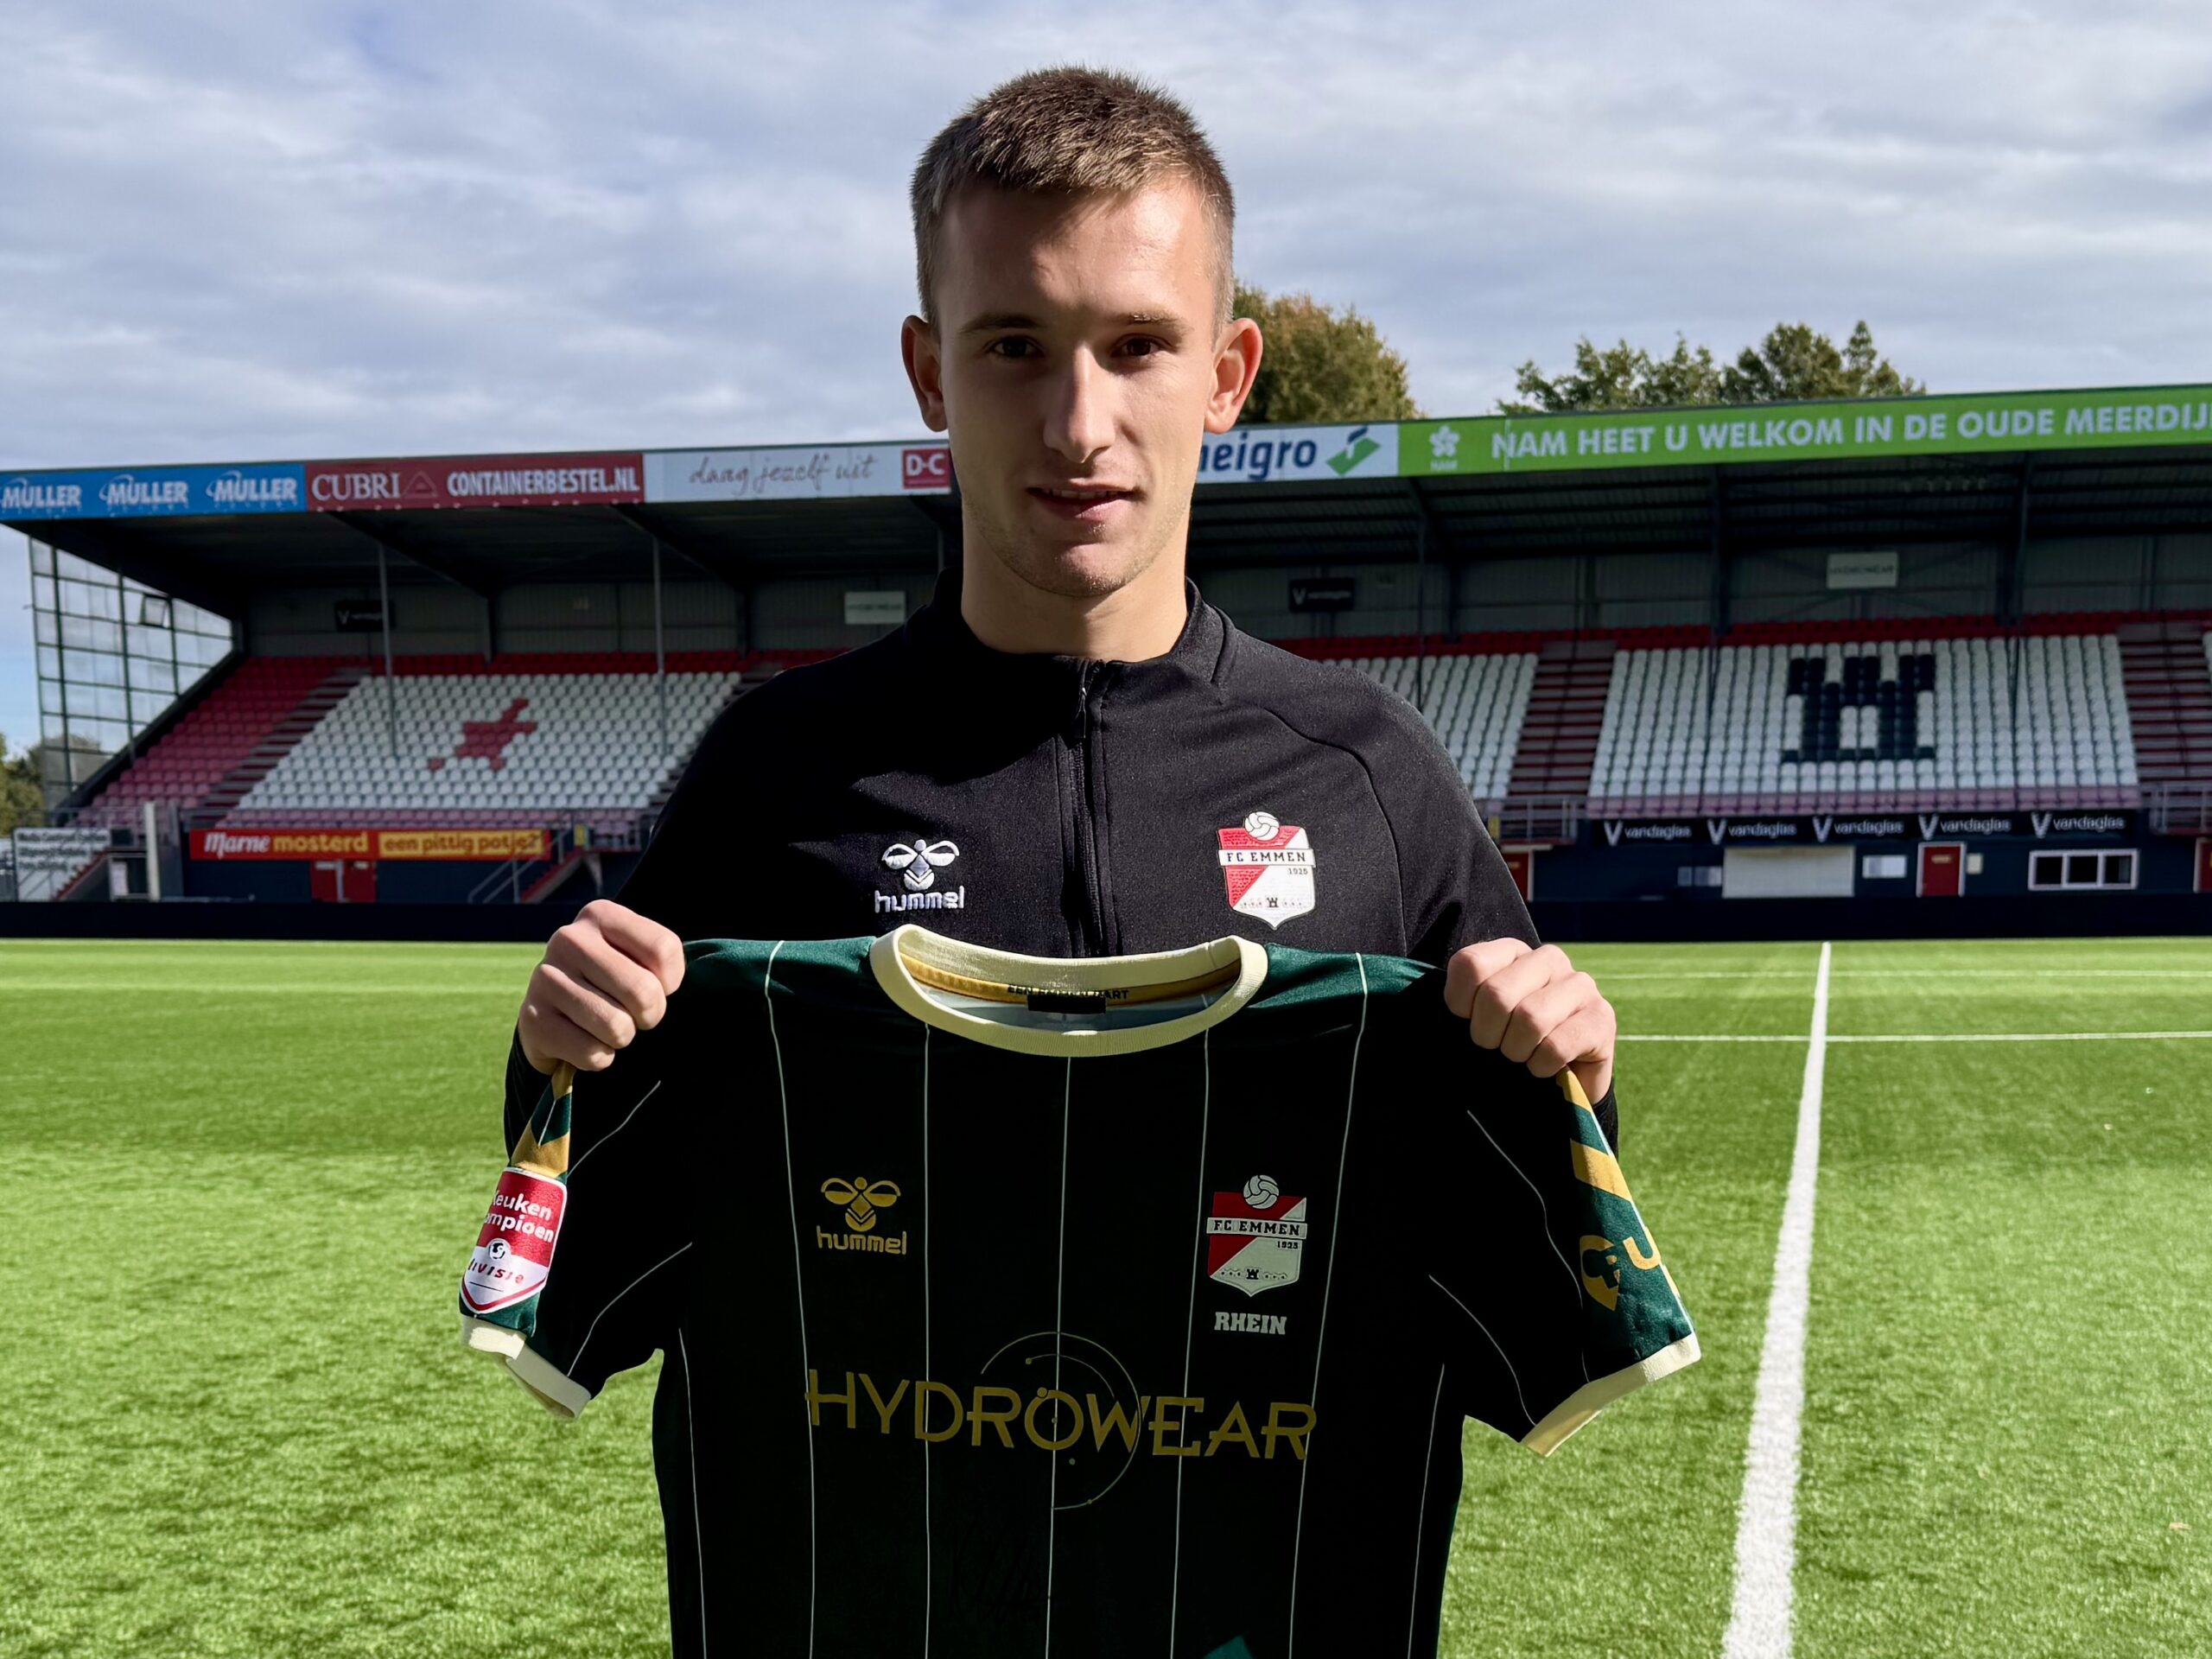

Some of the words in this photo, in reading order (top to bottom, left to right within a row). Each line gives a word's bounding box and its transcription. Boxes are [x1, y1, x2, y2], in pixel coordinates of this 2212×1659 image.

[1492, 431, 1567, 458] NAM
[1579, 426, 1655, 454] HEET
[1665, 424, 1688, 450] U
[1698, 418, 1844, 449] WELKOM
[1855, 415, 1892, 443] IN
[1904, 412, 1947, 442] DE
[1957, 409, 2055, 439] OUDE
[2065, 402, 2212, 435] MEERDIJ
[311, 472, 401, 501] CUBRI
[447, 467, 640, 497] CONTAINERBESTEL.NL
[204, 831, 270, 860] Marne
[273, 831, 368, 853] mosterd
[385, 839, 418, 852] een
[423, 832, 474, 855] pittig
[1227, 852, 1243, 862] FC
[1250, 852, 1306, 862] EMMEN
[874, 885, 965, 913] hummel
[817, 1225, 907, 1255] hummel
[1214, 1220, 1231, 1230] FC
[1239, 1221, 1300, 1236] EMMEN
[1277, 1241, 1299, 1249] 1925
[1214, 1312, 1287, 1335] RHEIN
[804, 1369, 1317, 1459] HYDROWEAR
